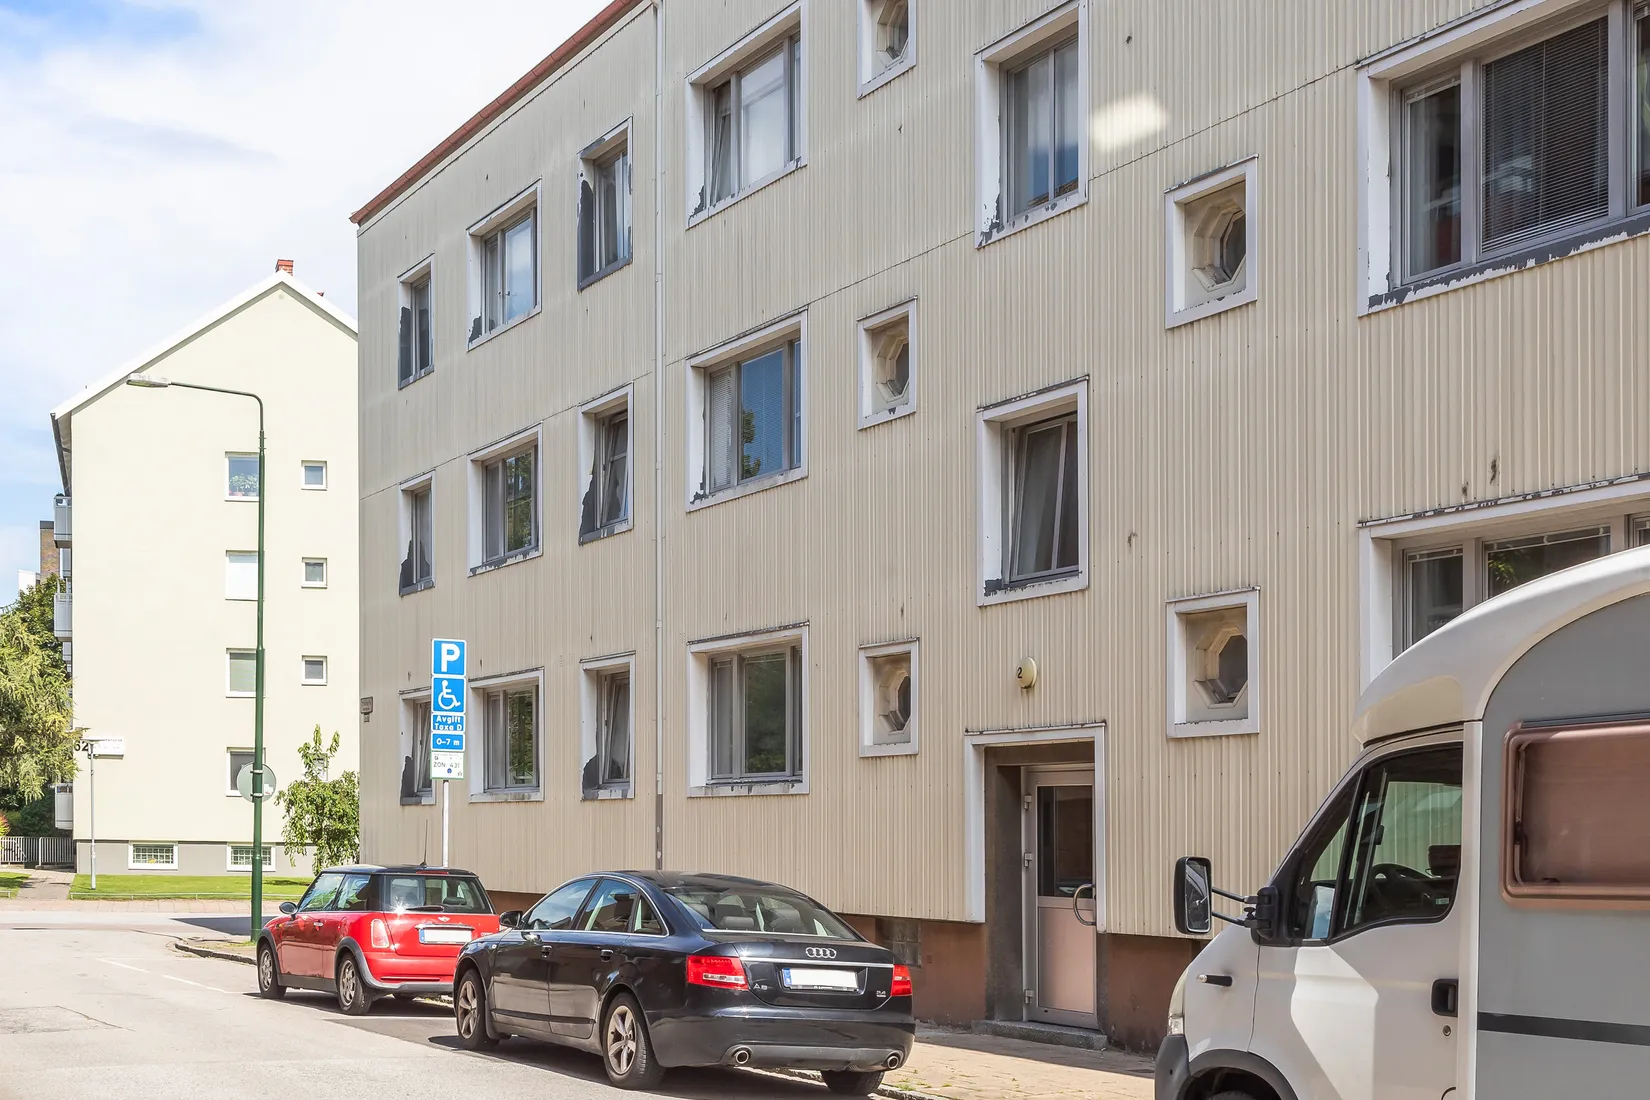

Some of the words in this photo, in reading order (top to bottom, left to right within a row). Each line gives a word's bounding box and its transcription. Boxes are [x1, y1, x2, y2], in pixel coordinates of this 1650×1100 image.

[441, 643, 460, 672] P
[1017, 666, 1023, 678] 2
[436, 715, 461, 724] Avgift
[434, 723, 454, 731] Taxa
[74, 740, 89, 751] 62
